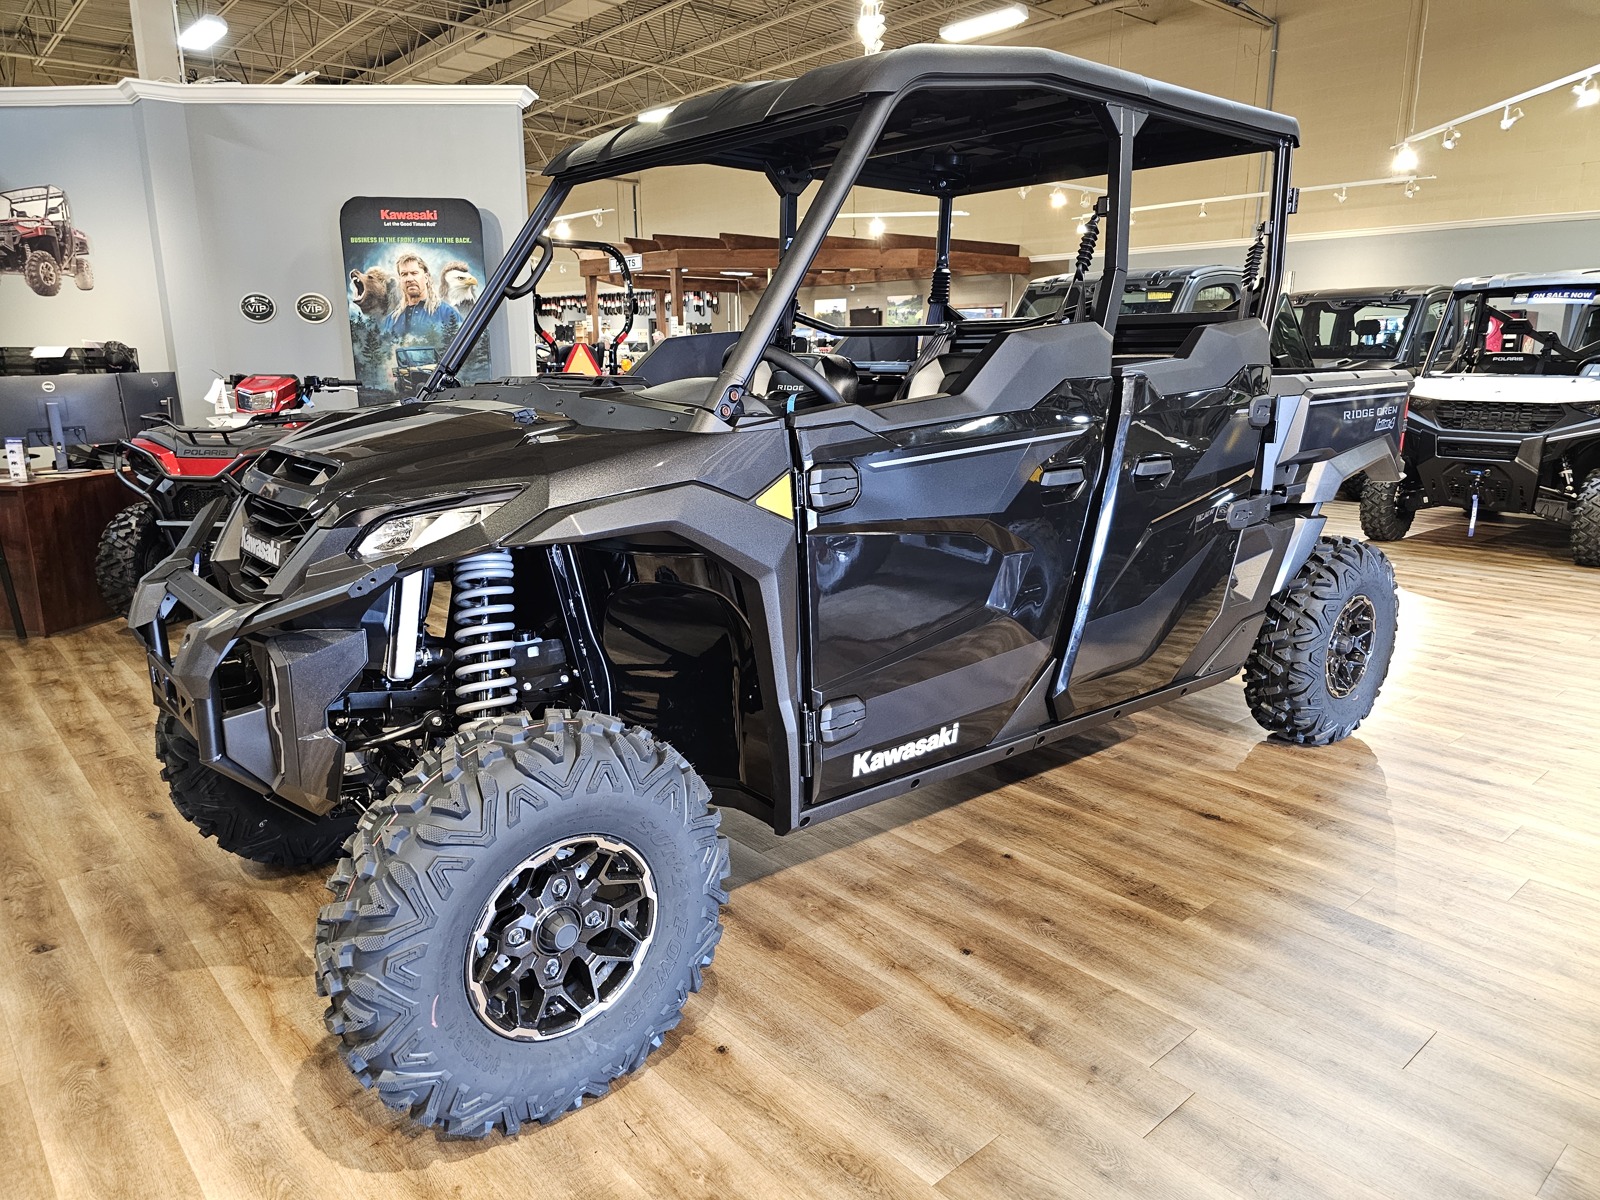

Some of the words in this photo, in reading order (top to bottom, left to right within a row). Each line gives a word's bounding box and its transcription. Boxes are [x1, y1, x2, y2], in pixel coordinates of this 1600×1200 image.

[380, 209, 438, 220] Kawasaki
[247, 305, 267, 313] VIP
[303, 305, 322, 313] VIP
[1343, 408, 1375, 420] RIDGE
[1376, 406, 1398, 416] CREW
[1453, 410, 1533, 422] POLARIS
[241, 526, 280, 566] Kawasaki
[852, 722, 959, 778] Kawasaki
